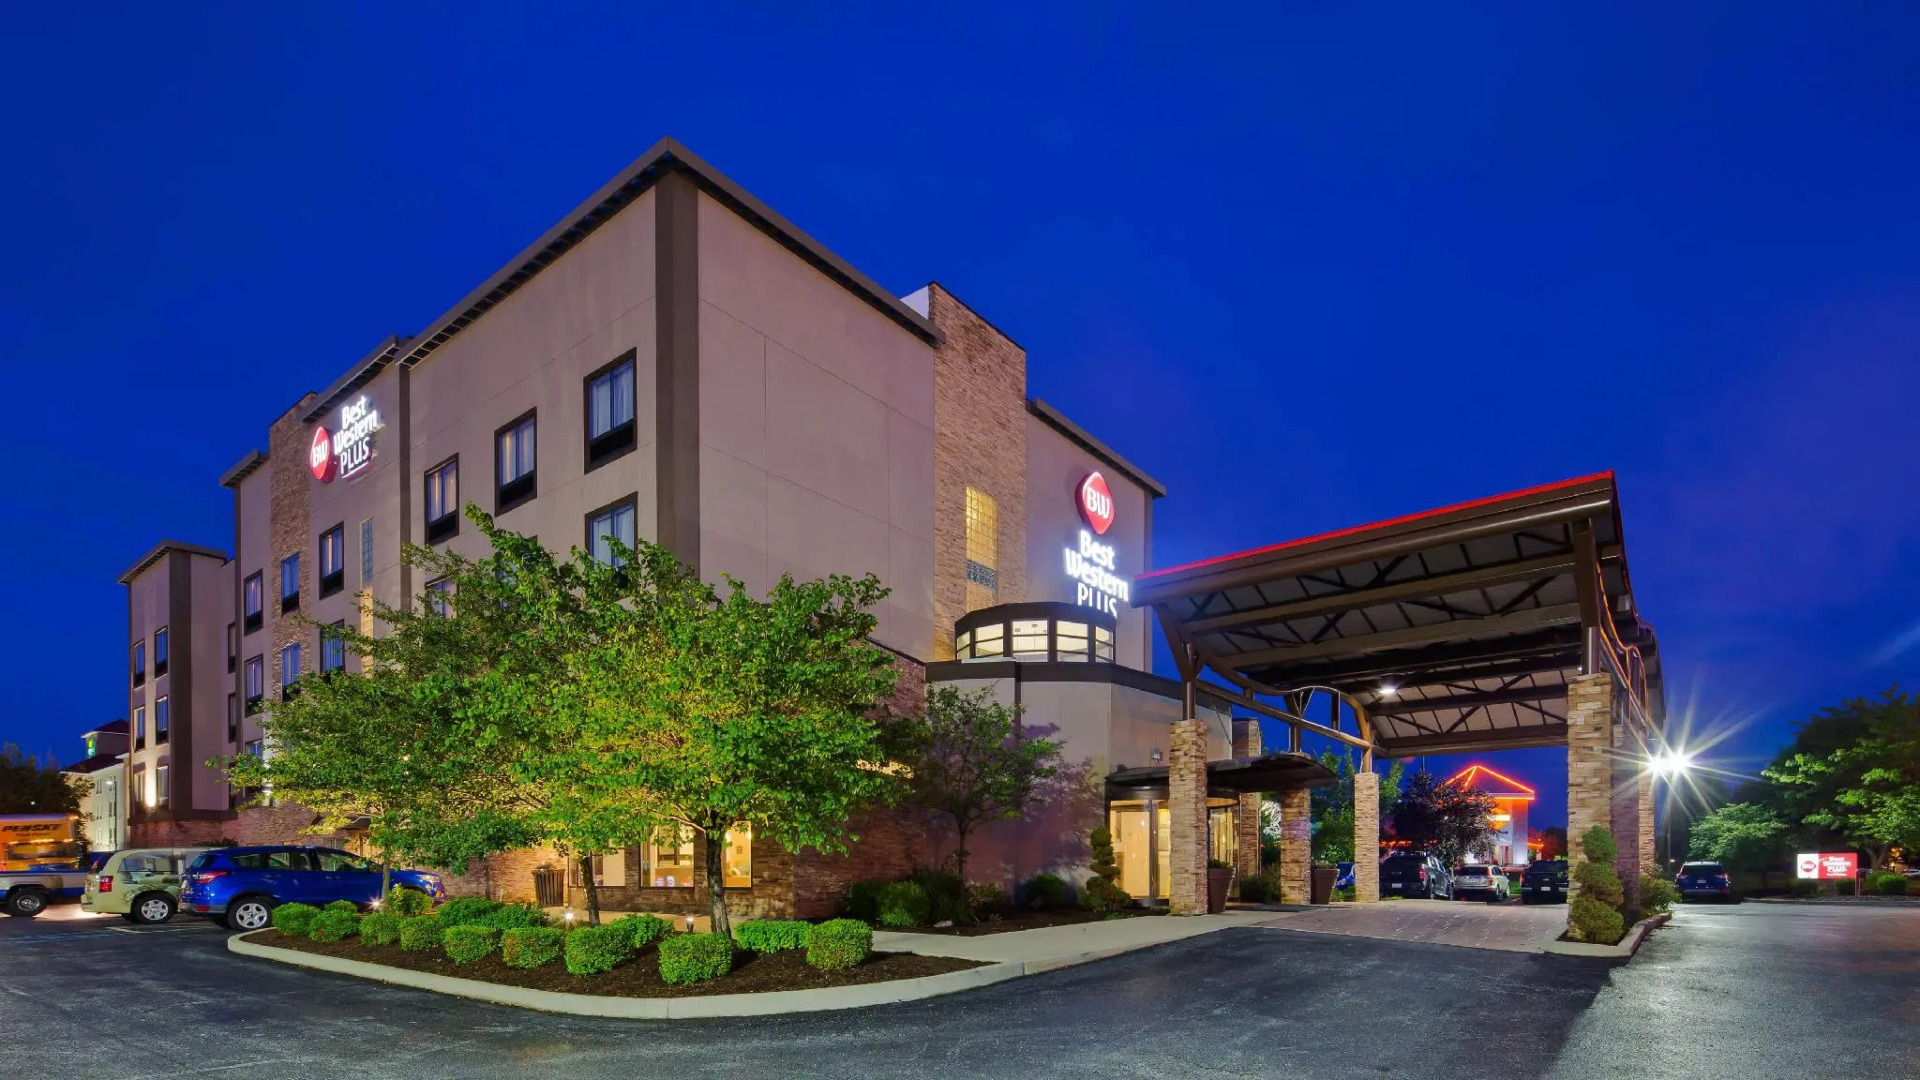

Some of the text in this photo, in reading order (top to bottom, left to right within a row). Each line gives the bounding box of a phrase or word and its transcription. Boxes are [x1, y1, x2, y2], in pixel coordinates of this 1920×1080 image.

[342, 395, 366, 429] Best
[334, 410, 377, 455] Western
[312, 439, 328, 468] BW
[341, 436, 370, 474] PLUS
[1087, 486, 1110, 519] BW
[1080, 530, 1115, 570] Best
[1065, 548, 1129, 601] Western
[2, 823, 62, 832] PENSKE
